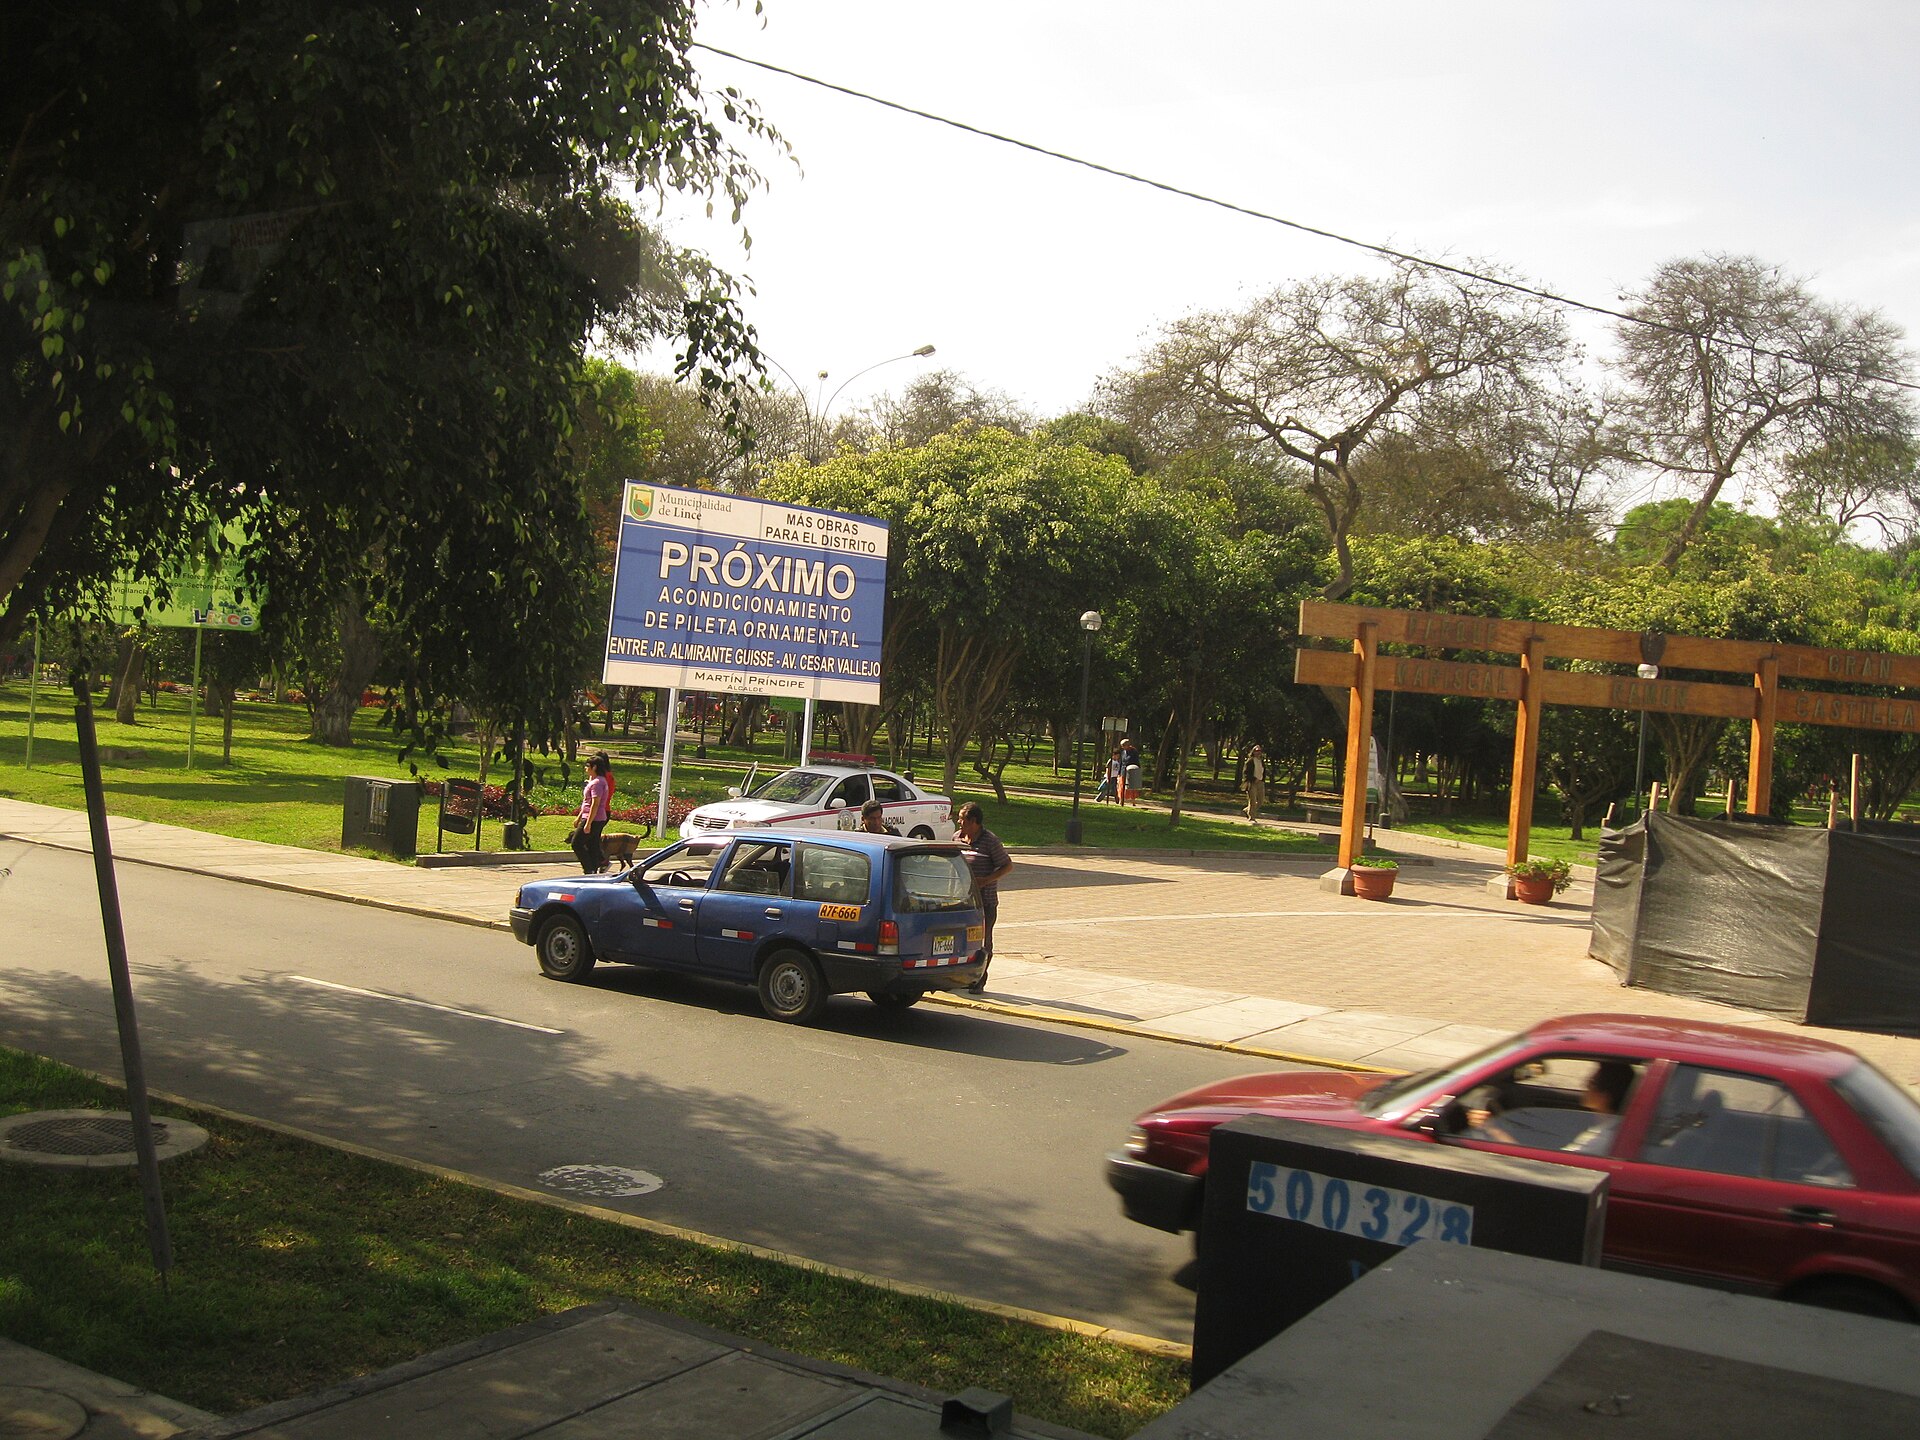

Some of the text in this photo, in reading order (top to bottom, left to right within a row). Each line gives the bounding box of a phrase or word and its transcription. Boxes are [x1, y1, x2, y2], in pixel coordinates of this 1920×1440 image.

[658, 505, 702, 520] de Lince
[659, 492, 732, 513] Municipalidad
[765, 526, 876, 553] PARA EL DISTRITO
[786, 513, 859, 536] MÁS OBRAS
[659, 540, 857, 601] PRÓXIMO
[658, 586, 852, 623] ACONDICIONAMIENTO
[644, 610, 860, 648] DE PILETA ORNAMENTAL
[1407, 615, 1893, 680] PARQUE GRAN
[609, 636, 649, 657] ENTRE
[650, 640, 667, 658] JR.
[669, 642, 733, 664] ALMIRANTE
[735, 648, 775, 668] GUISSE
[781, 652, 797, 670] AV.
[799, 653, 835, 673] CESAR
[837, 657, 881, 677] VALLEJO
[1395, 661, 1508, 694] MARISCAL
[1796, 697, 1914, 727] CASTILLA
[820, 904, 857, 920] A7F-666
[1248, 1161, 1472, 1245] 500328
